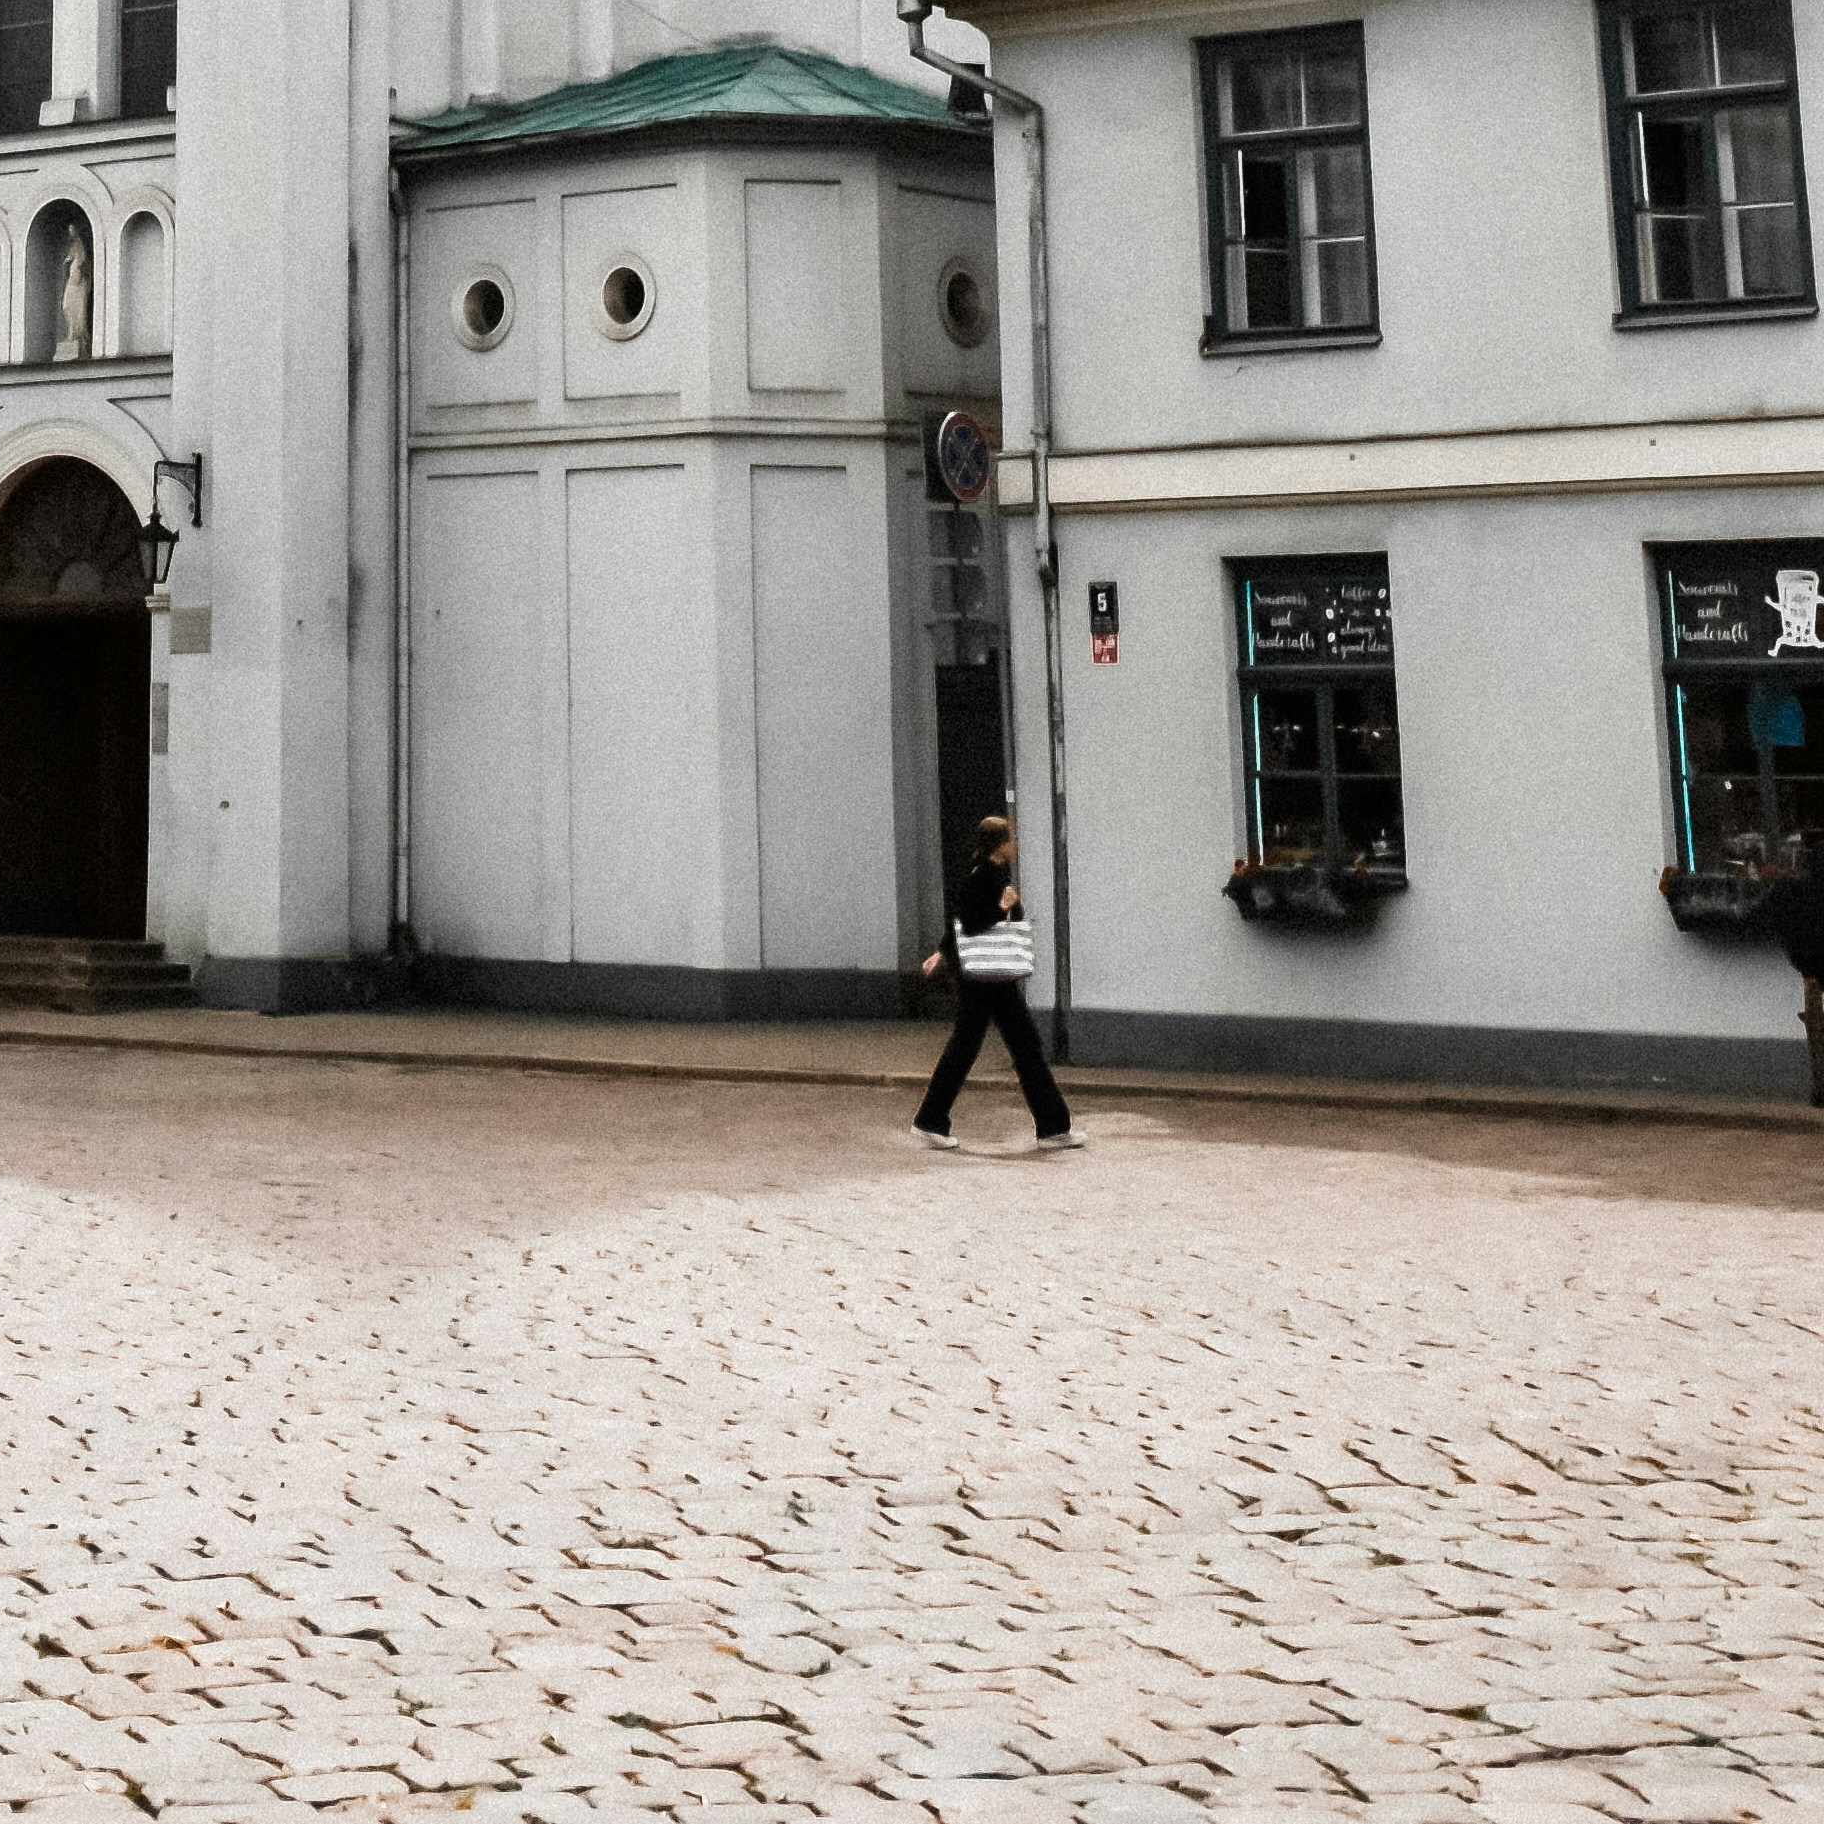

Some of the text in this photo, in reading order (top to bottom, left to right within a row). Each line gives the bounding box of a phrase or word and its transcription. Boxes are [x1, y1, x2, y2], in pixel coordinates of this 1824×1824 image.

[1097, 592, 1107, 611] 5
[1697, 599, 1721, 619] and
[1270, 610, 1292, 627] and
